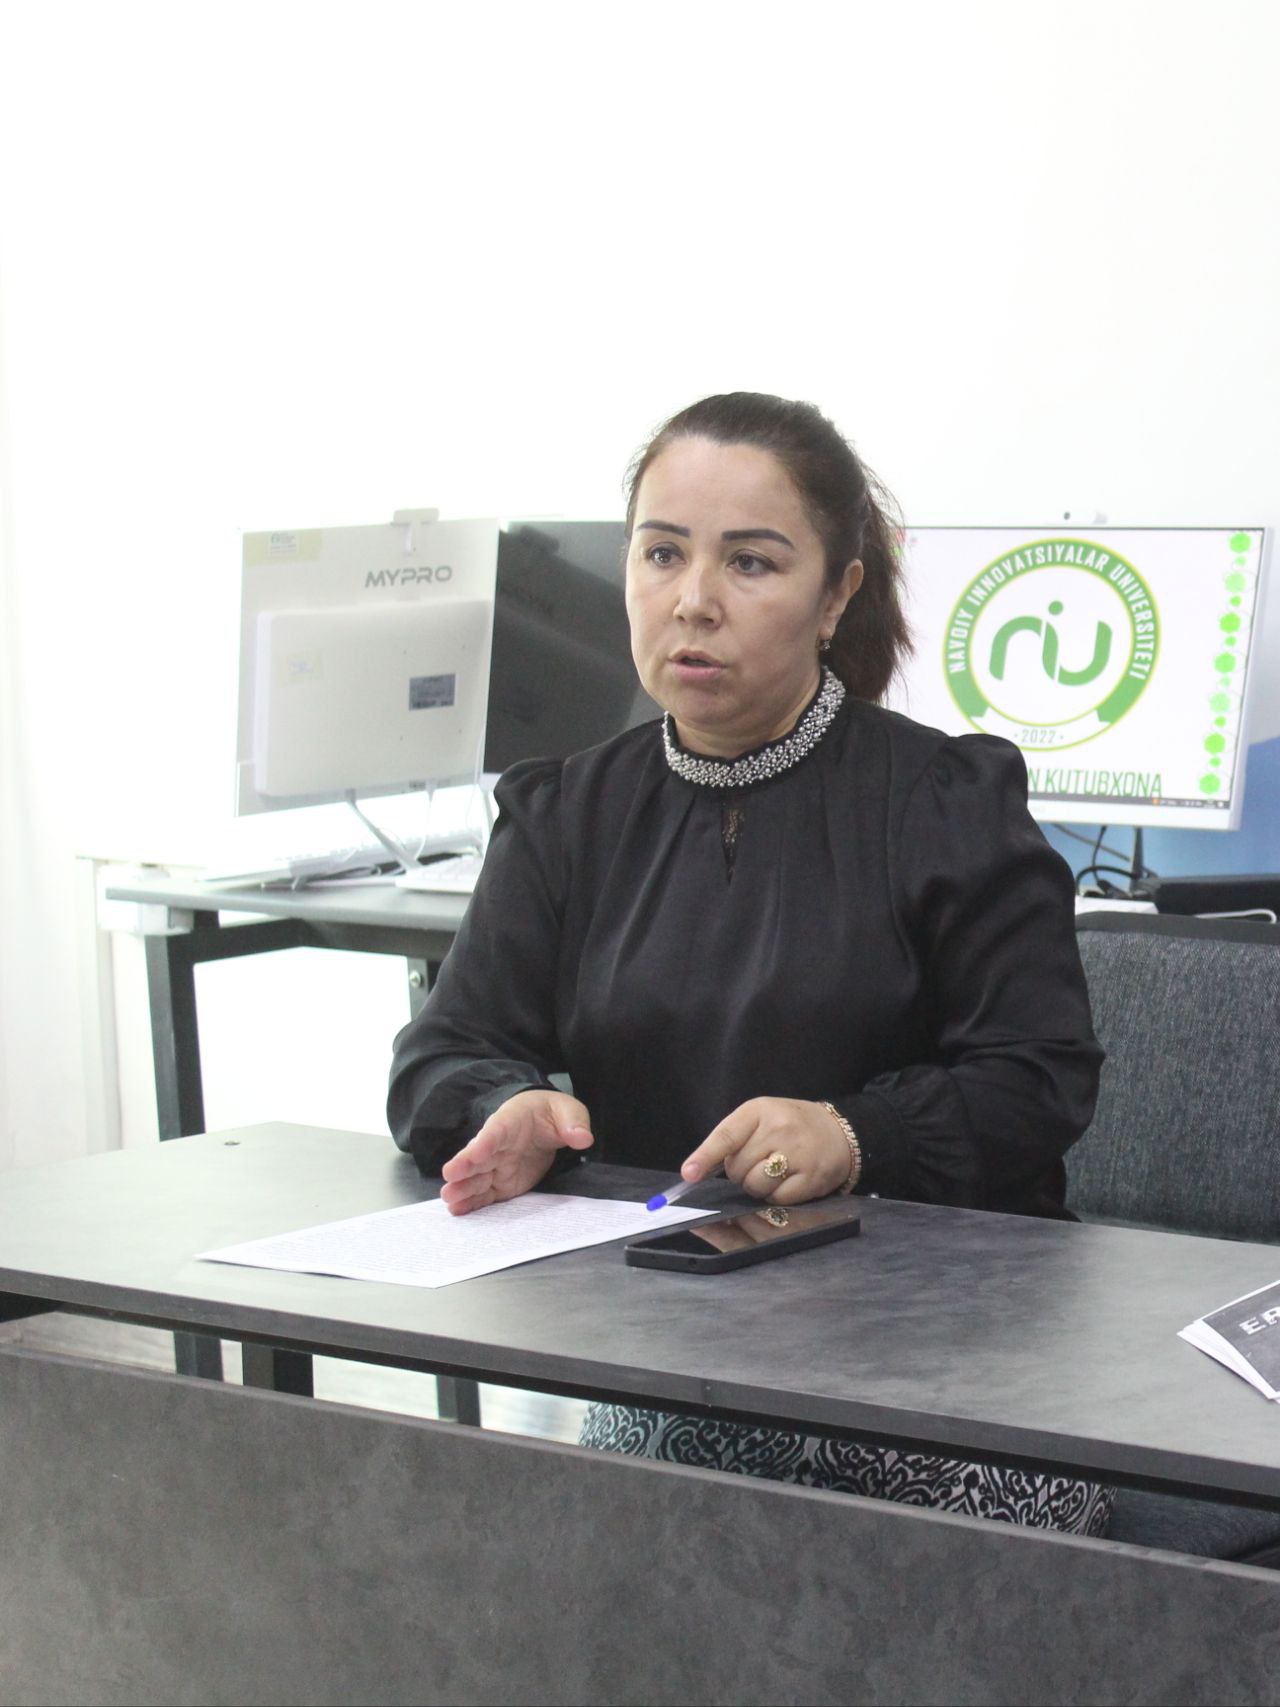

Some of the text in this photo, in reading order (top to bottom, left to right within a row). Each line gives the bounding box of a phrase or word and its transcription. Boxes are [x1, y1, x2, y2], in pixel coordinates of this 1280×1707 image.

[364, 564, 453, 589] MYPRO
[948, 544, 1155, 680] NAVOIY INNOVATSIYALAR UNIVERSITETI
[1045, 768, 1162, 798] KUTUBXONA
